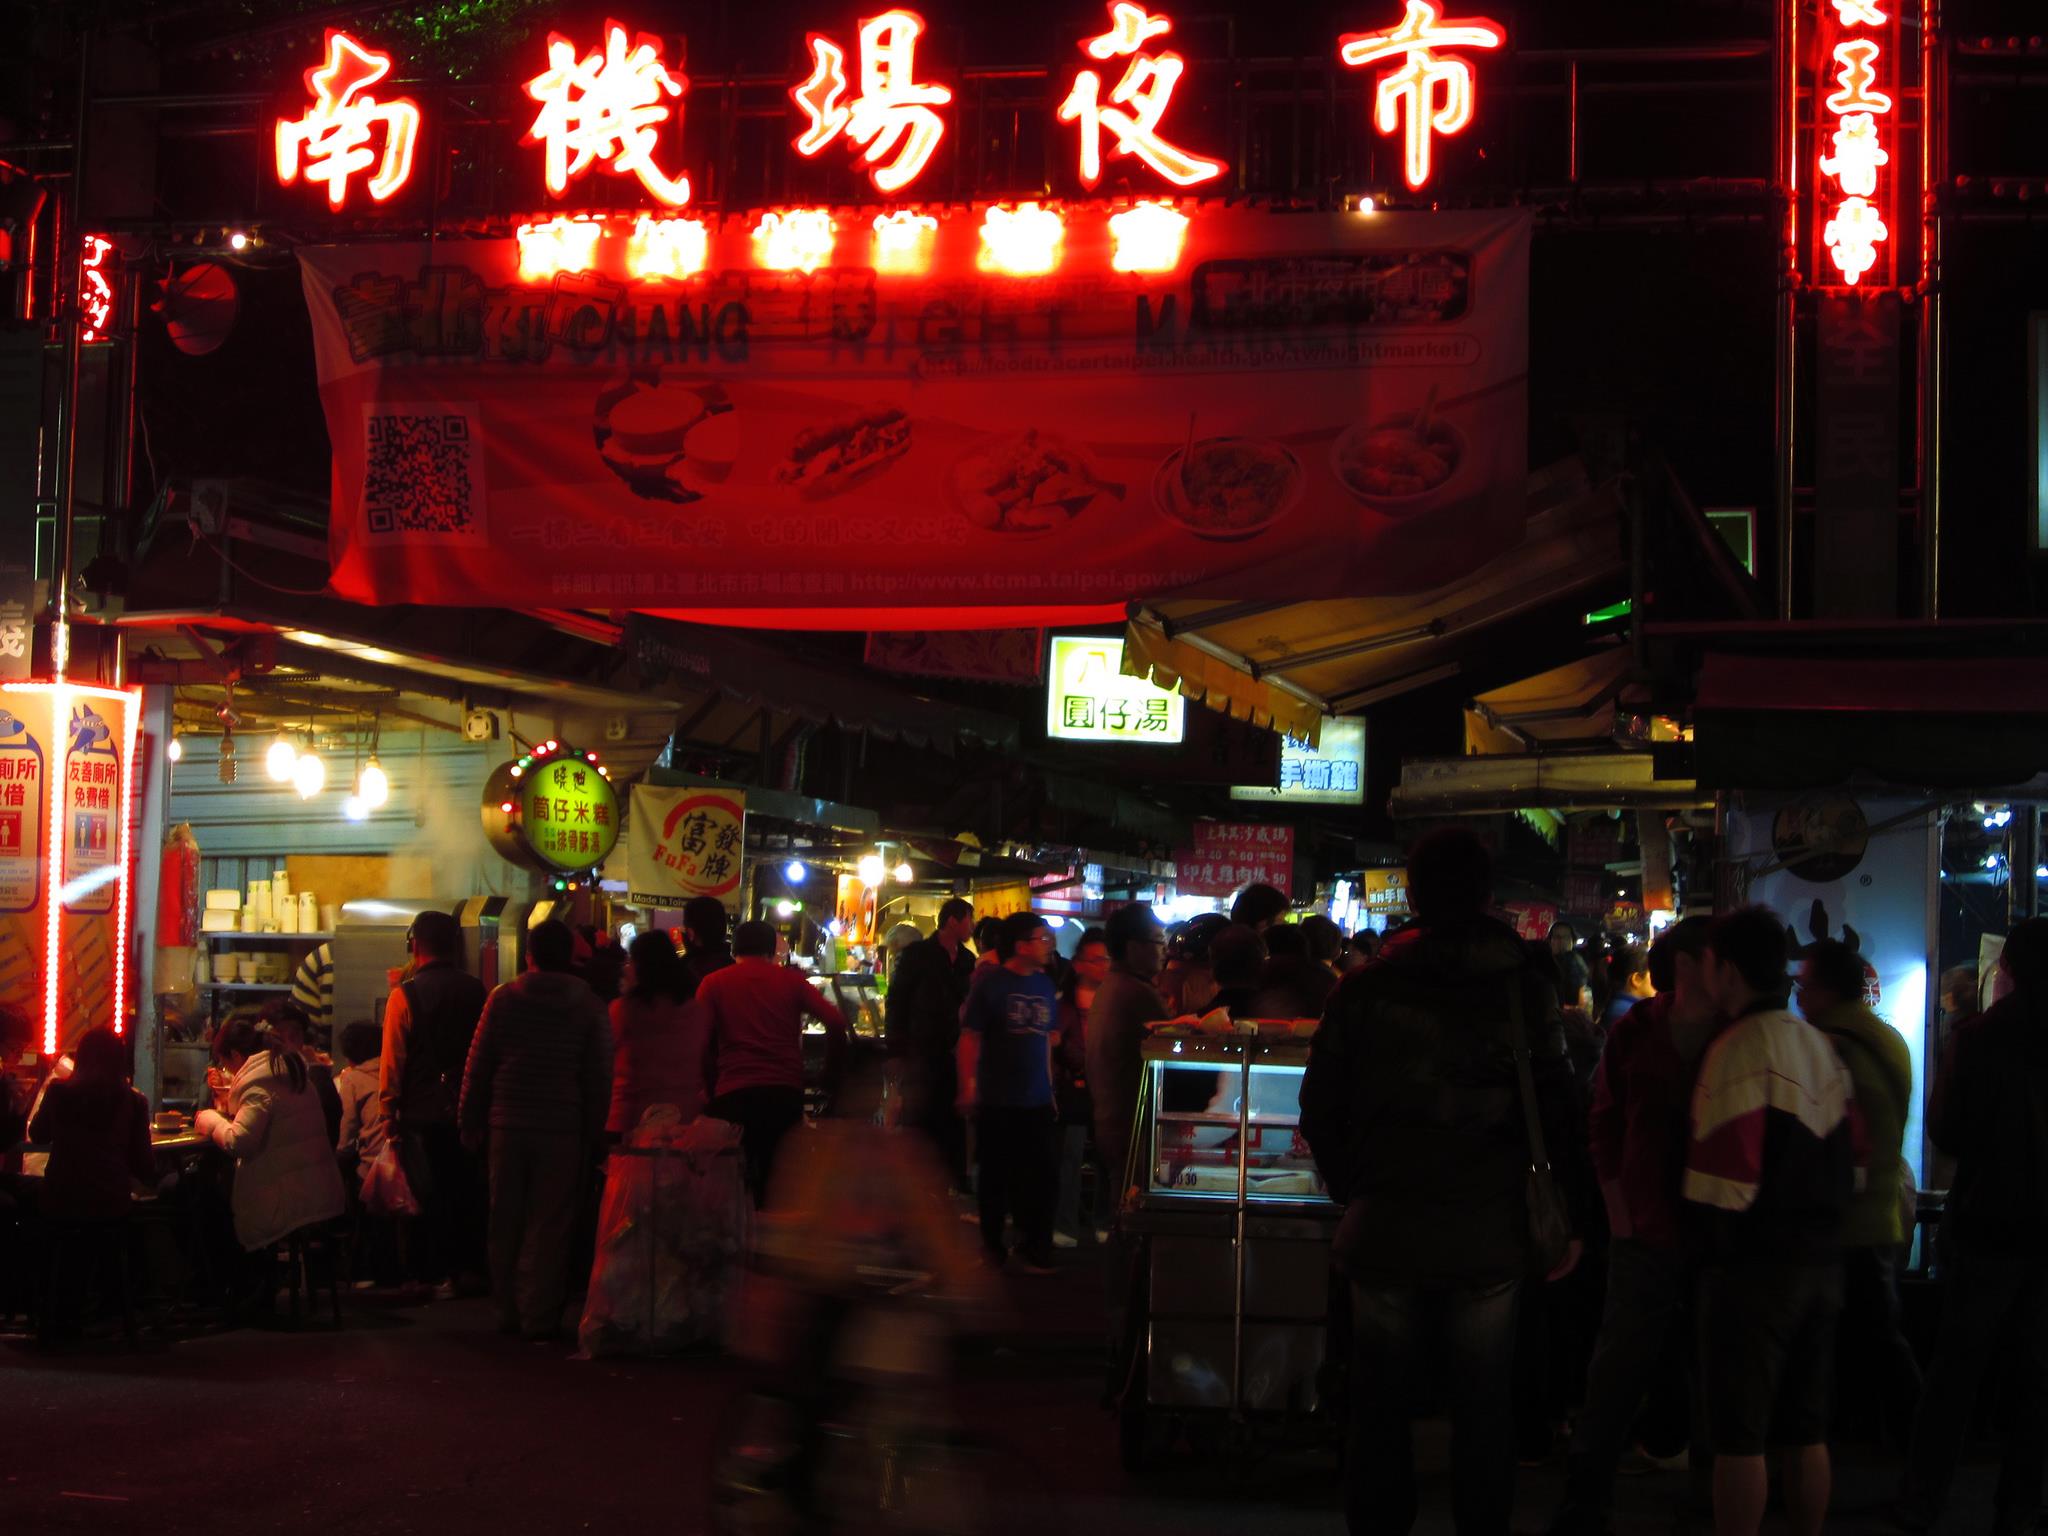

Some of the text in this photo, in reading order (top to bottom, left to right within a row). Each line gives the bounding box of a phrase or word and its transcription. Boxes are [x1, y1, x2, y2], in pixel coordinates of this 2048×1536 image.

[274, 0, 1507, 212] 南機場夜市
[1063, 695, 1169, 732] 圓仔湯
[1281, 759, 1359, 792] 手撕雞
[0, 783, 25, 807] 借
[74, 786, 110, 810] 免費借
[532, 795, 609, 826] 筒仔米糕
[652, 844, 699, 878] FuFa
[633, 894, 657, 905] Made
